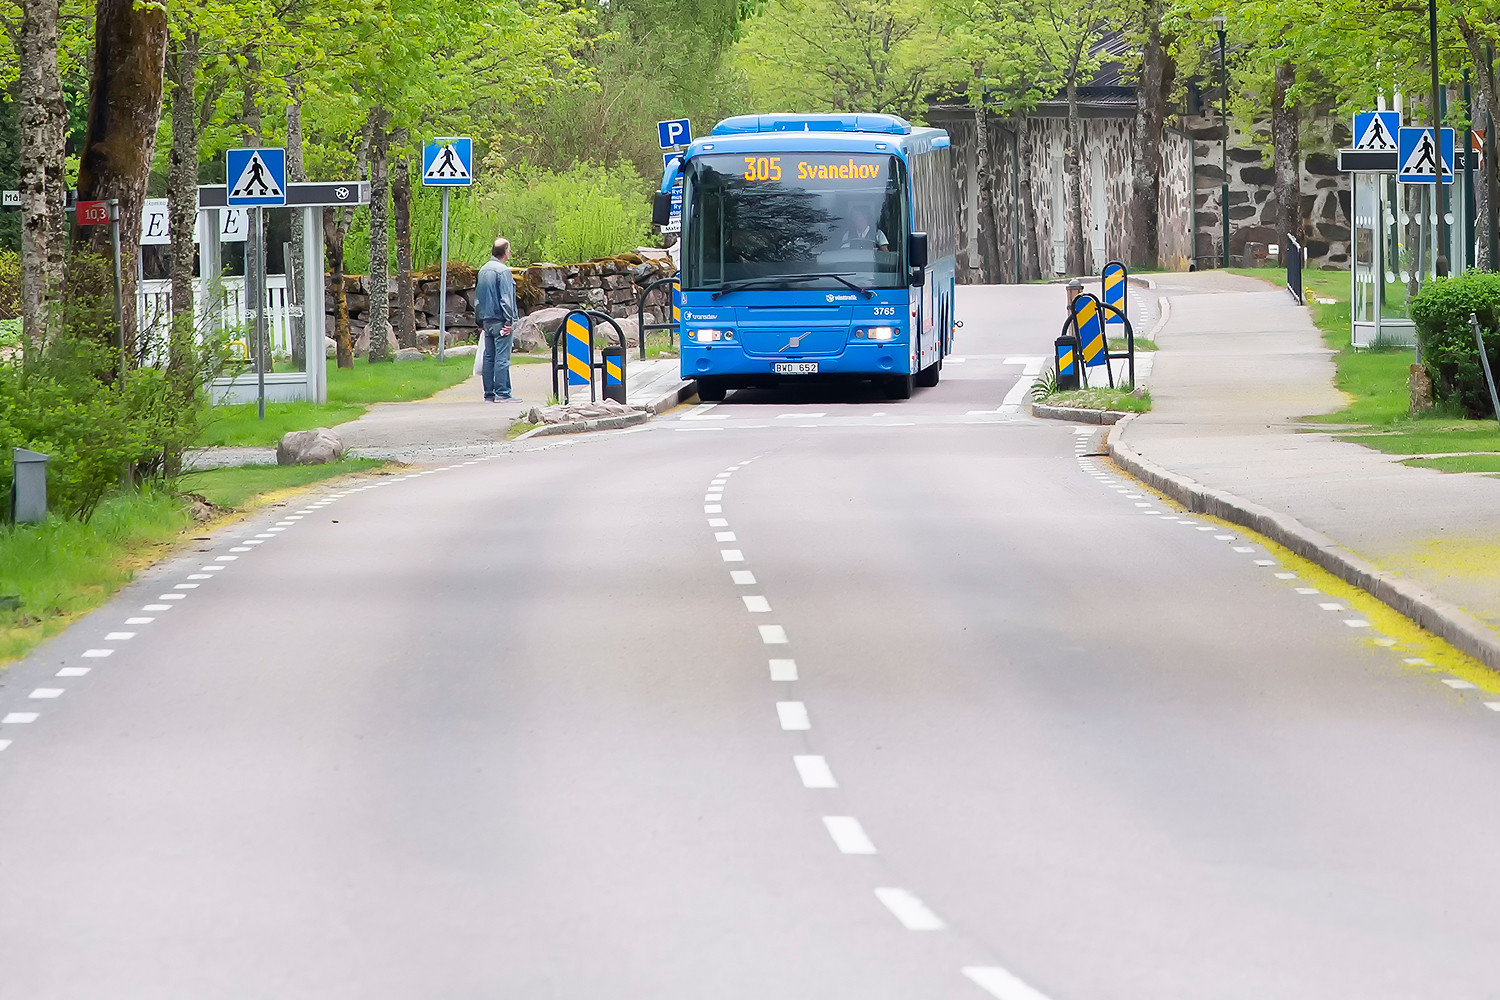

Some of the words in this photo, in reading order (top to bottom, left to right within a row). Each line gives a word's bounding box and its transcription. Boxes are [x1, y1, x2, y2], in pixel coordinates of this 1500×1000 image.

[668, 122, 683, 144] P
[744, 157, 782, 181] 305
[798, 158, 880, 179] Svanehov
[85, 208, 106, 222] 10,3
[873, 307, 895, 316] 3765
[776, 364, 793, 372] BWD
[799, 364, 816, 372] 652
